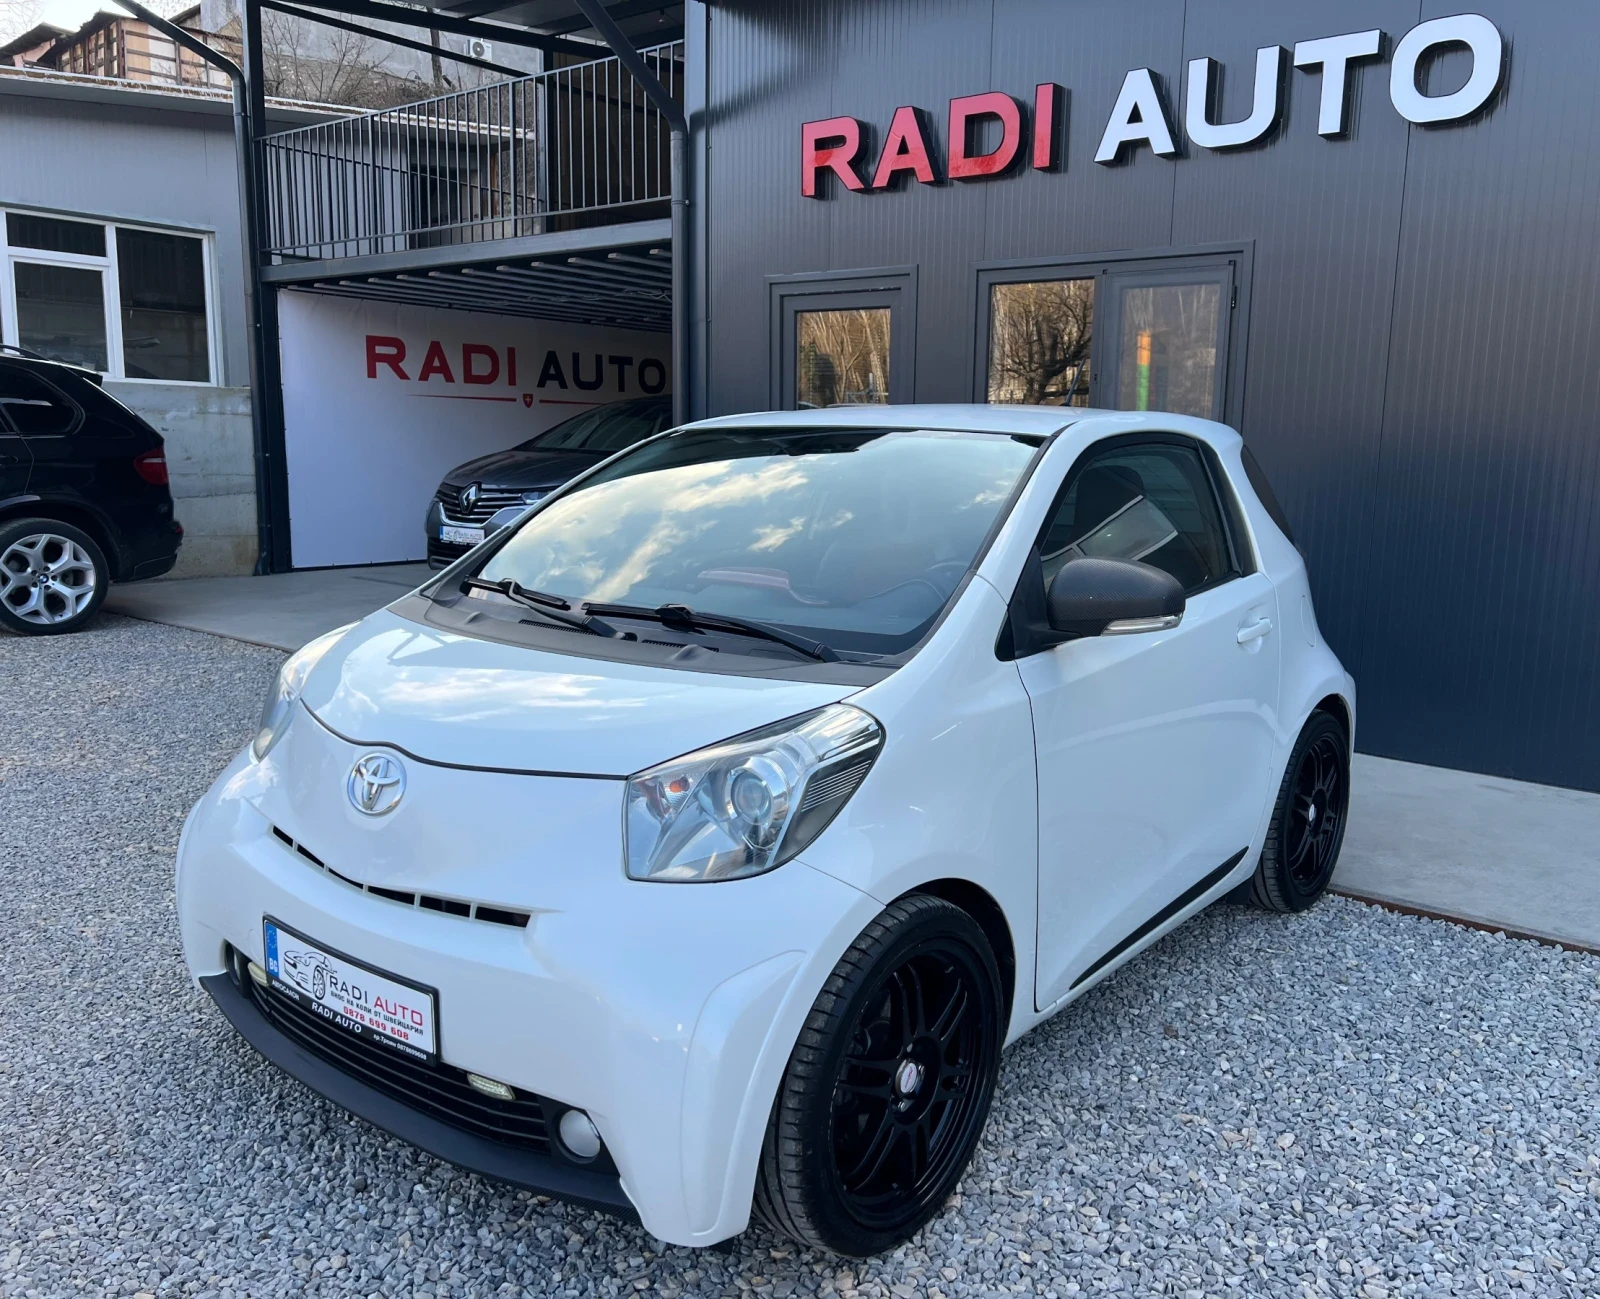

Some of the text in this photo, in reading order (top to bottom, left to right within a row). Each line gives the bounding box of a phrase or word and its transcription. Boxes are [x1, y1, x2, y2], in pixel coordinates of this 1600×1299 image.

[801, 13, 1503, 198] RADI AUTO
[365, 334, 667, 394] RADI AUTO
[269, 957, 279, 973] BG
[311, 1001, 362, 1033] RADI AUTO
[329, 975, 423, 1027] RADI AUTO
[346, 997, 355, 1007] НА
[356, 1002, 372, 1015] КОЛИ
[373, 1010, 382, 1019] ОТ
[383, 1014, 424, 1036] ШВЕЙЦАРИЯ
[343, 1005, 409, 1041] 0878 699 608
